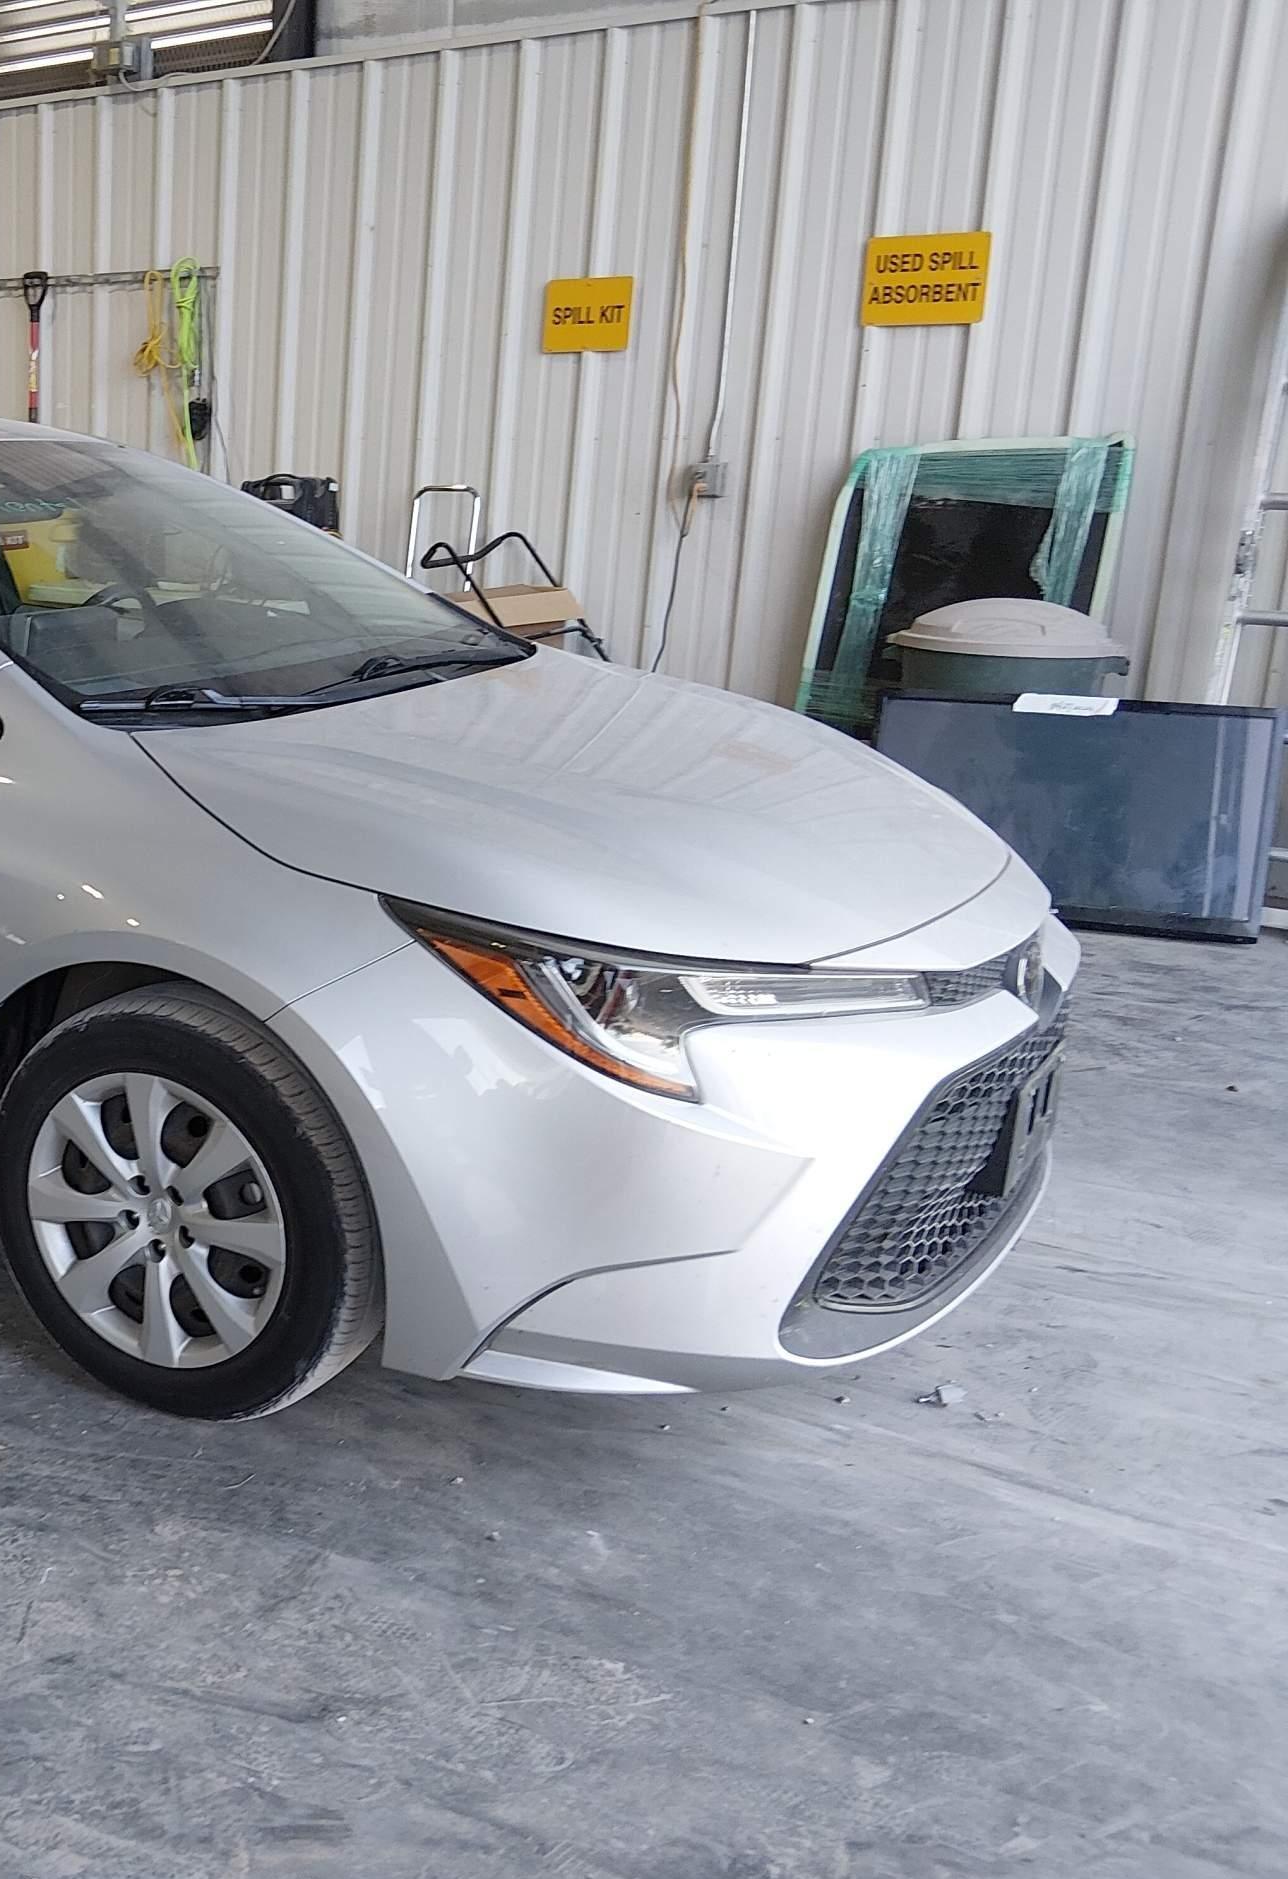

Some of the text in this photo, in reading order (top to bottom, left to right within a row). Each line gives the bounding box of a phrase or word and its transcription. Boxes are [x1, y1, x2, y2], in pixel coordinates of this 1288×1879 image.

[875, 250, 980, 274] USED SPILL
[867, 281, 982, 305] ABSORBENT
[552, 304, 625, 325] SPILL KIT
